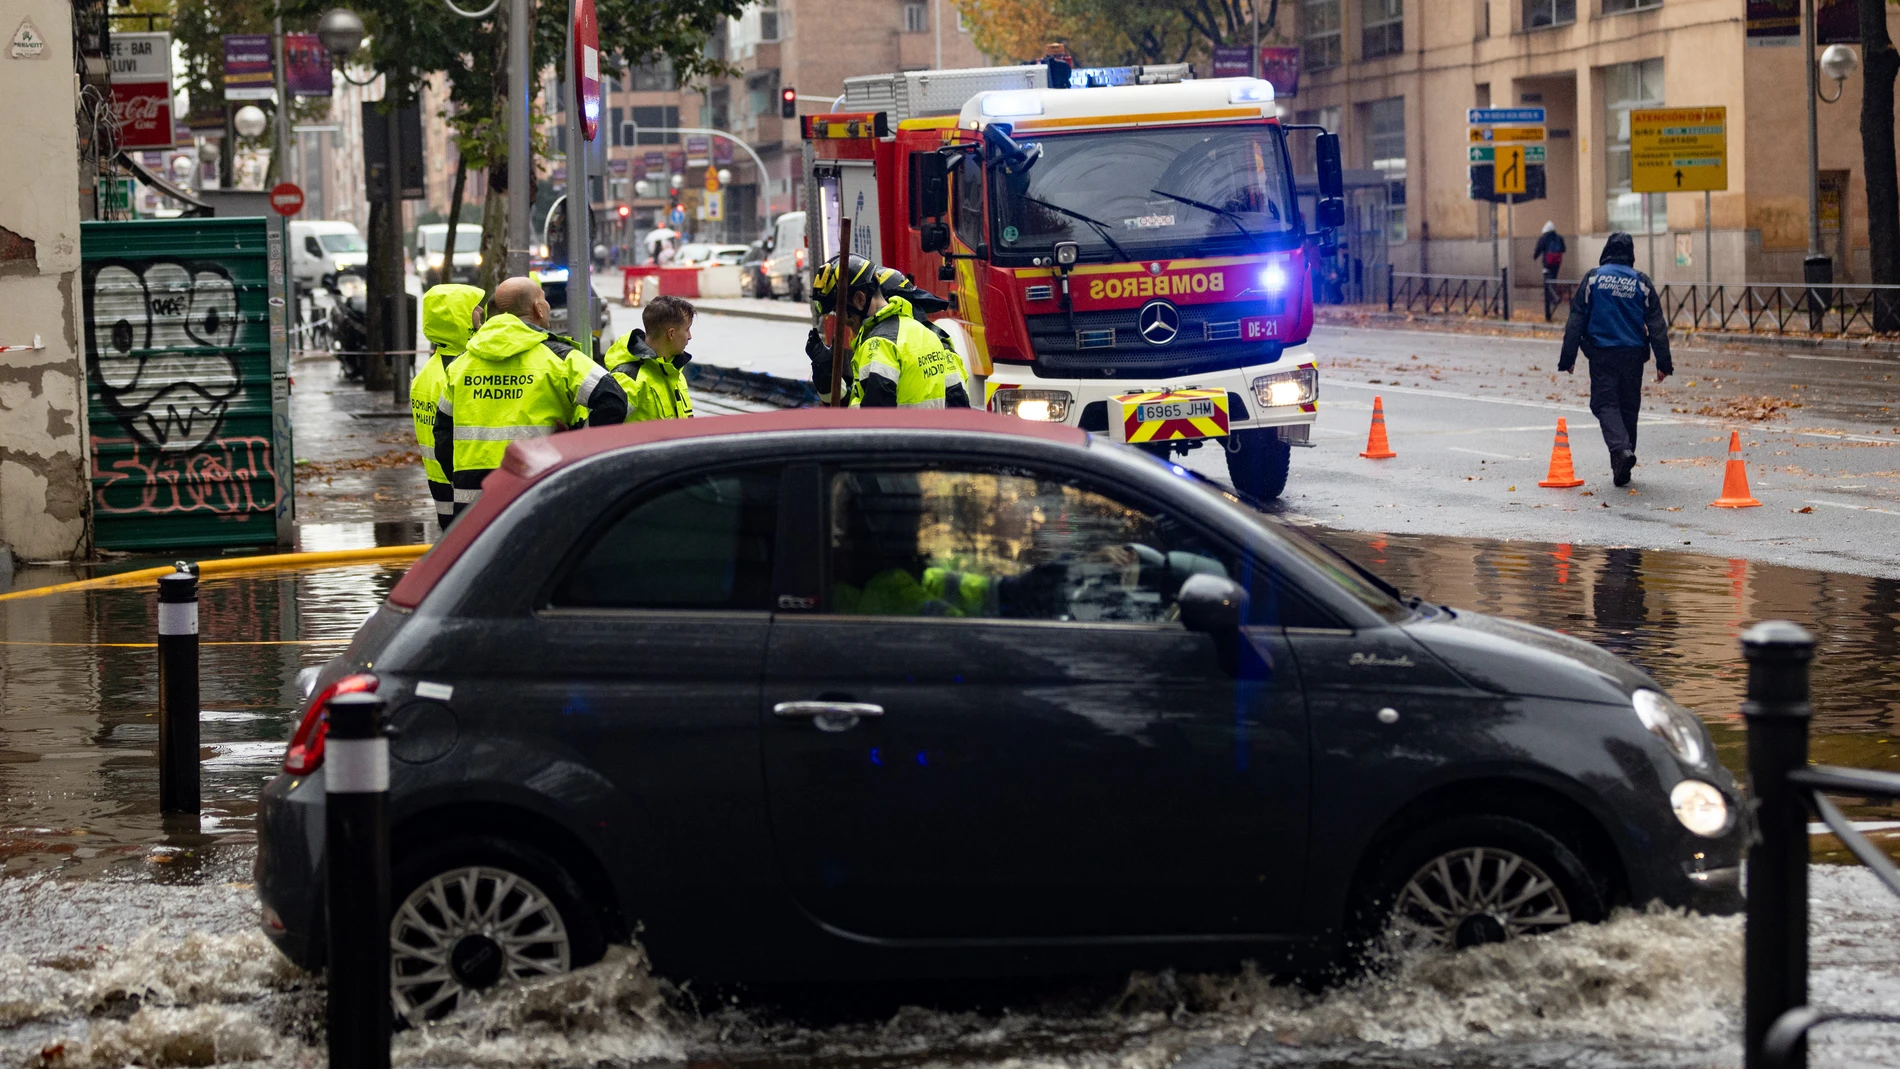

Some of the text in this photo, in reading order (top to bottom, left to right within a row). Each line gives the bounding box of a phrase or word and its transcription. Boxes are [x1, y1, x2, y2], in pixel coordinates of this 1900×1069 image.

[131, 42, 152, 55] BAR
[1598, 275, 1637, 286] POLICÍA
[1597, 283, 1637, 292] MUNICIPAL
[1248, 320, 1277, 337] DE-21
[464, 374, 534, 386] BOMBEROS
[473, 388, 523, 400] MADRID
[1146, 402, 1212, 419] 6965 JHM
